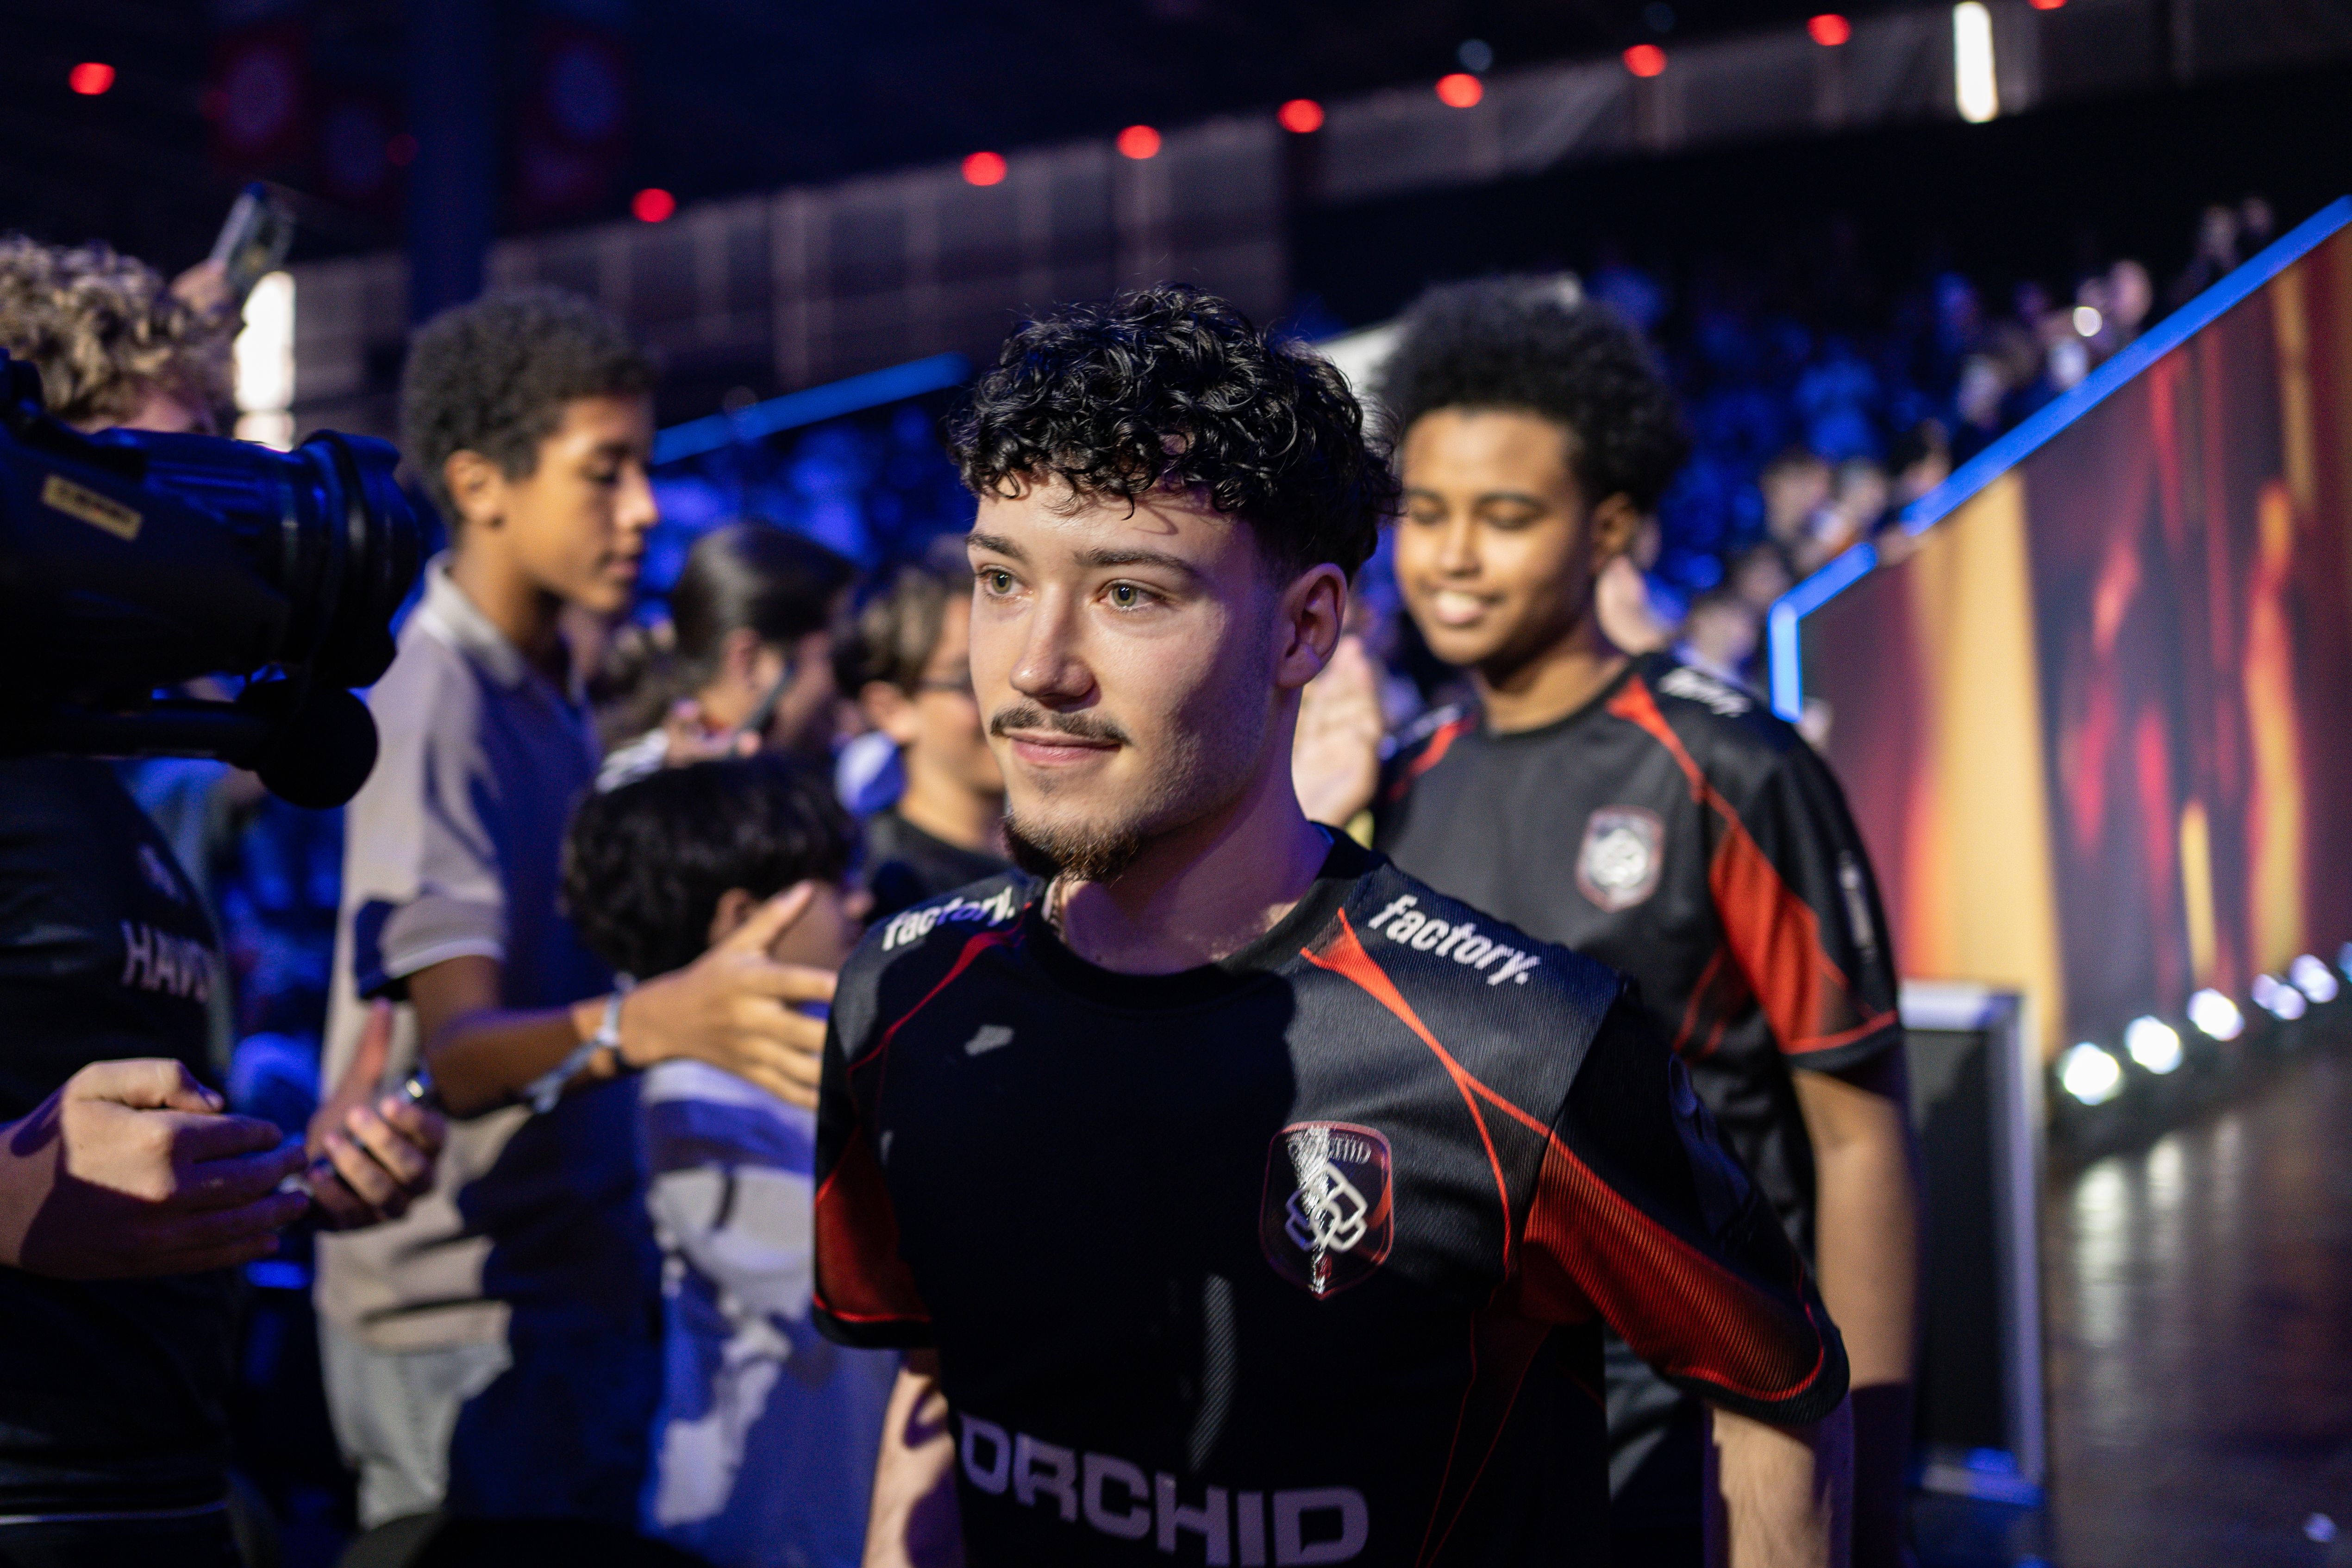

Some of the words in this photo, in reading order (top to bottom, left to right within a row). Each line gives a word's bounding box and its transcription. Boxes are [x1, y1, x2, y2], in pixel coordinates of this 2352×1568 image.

[882, 886, 1016, 951] factory.
[1368, 893, 1542, 986] factory.
[959, 1411, 1370, 1568] ORCHID
